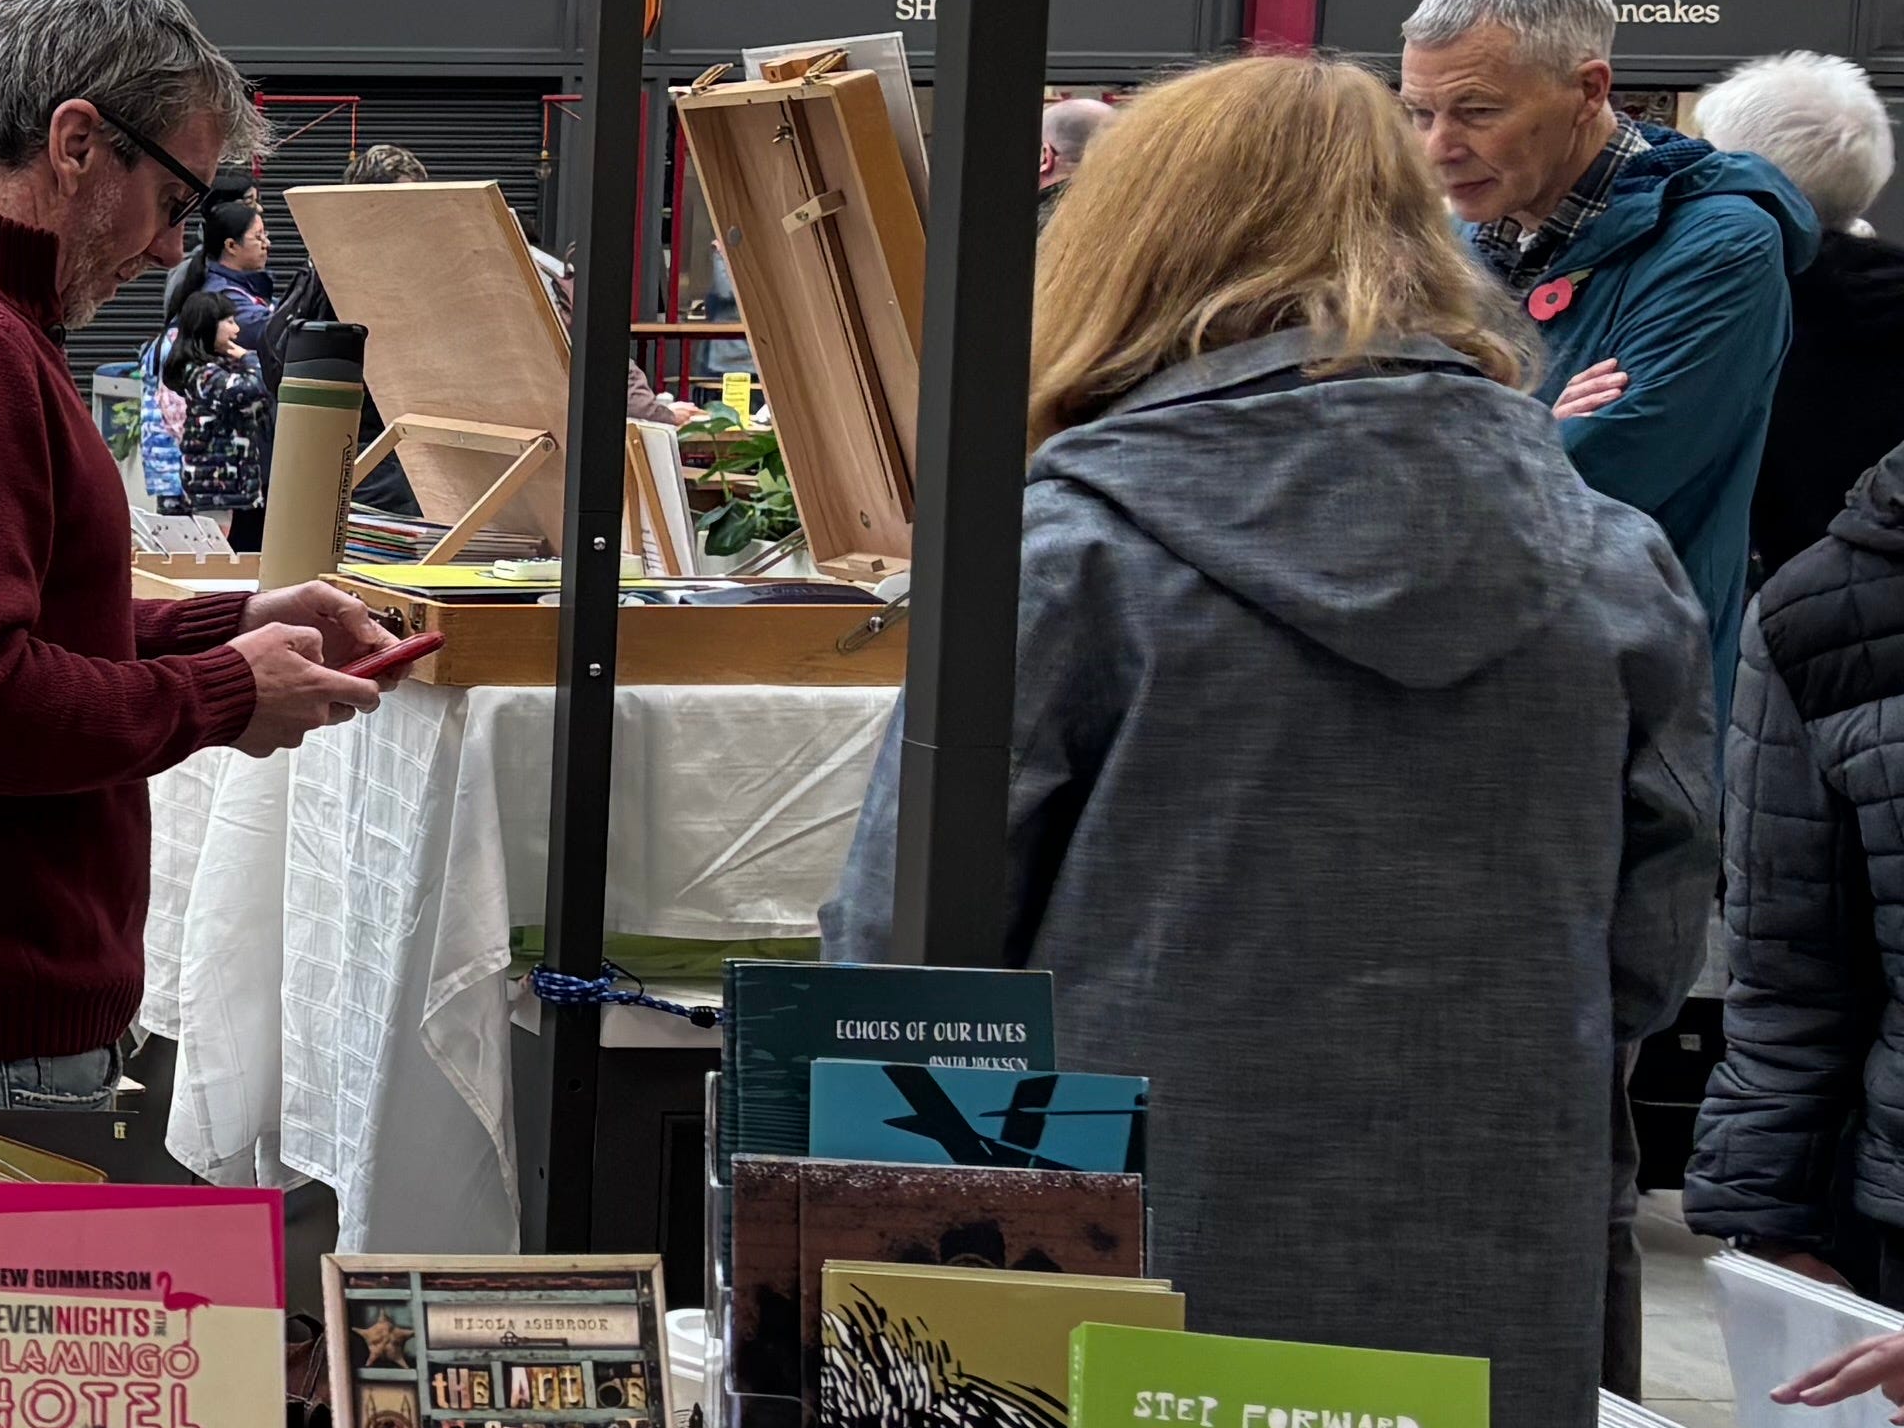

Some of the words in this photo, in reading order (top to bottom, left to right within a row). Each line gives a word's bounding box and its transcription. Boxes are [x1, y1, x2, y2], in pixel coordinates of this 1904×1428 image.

[836, 1020, 900, 1041] ECHOES
[906, 1021, 927, 1040] OF
[934, 1022, 972, 1042] OUR
[977, 1023, 1027, 1044] LIVES
[33, 1269, 152, 1291] GUMMERSON
[1133, 1391, 1218, 1428] STEP
